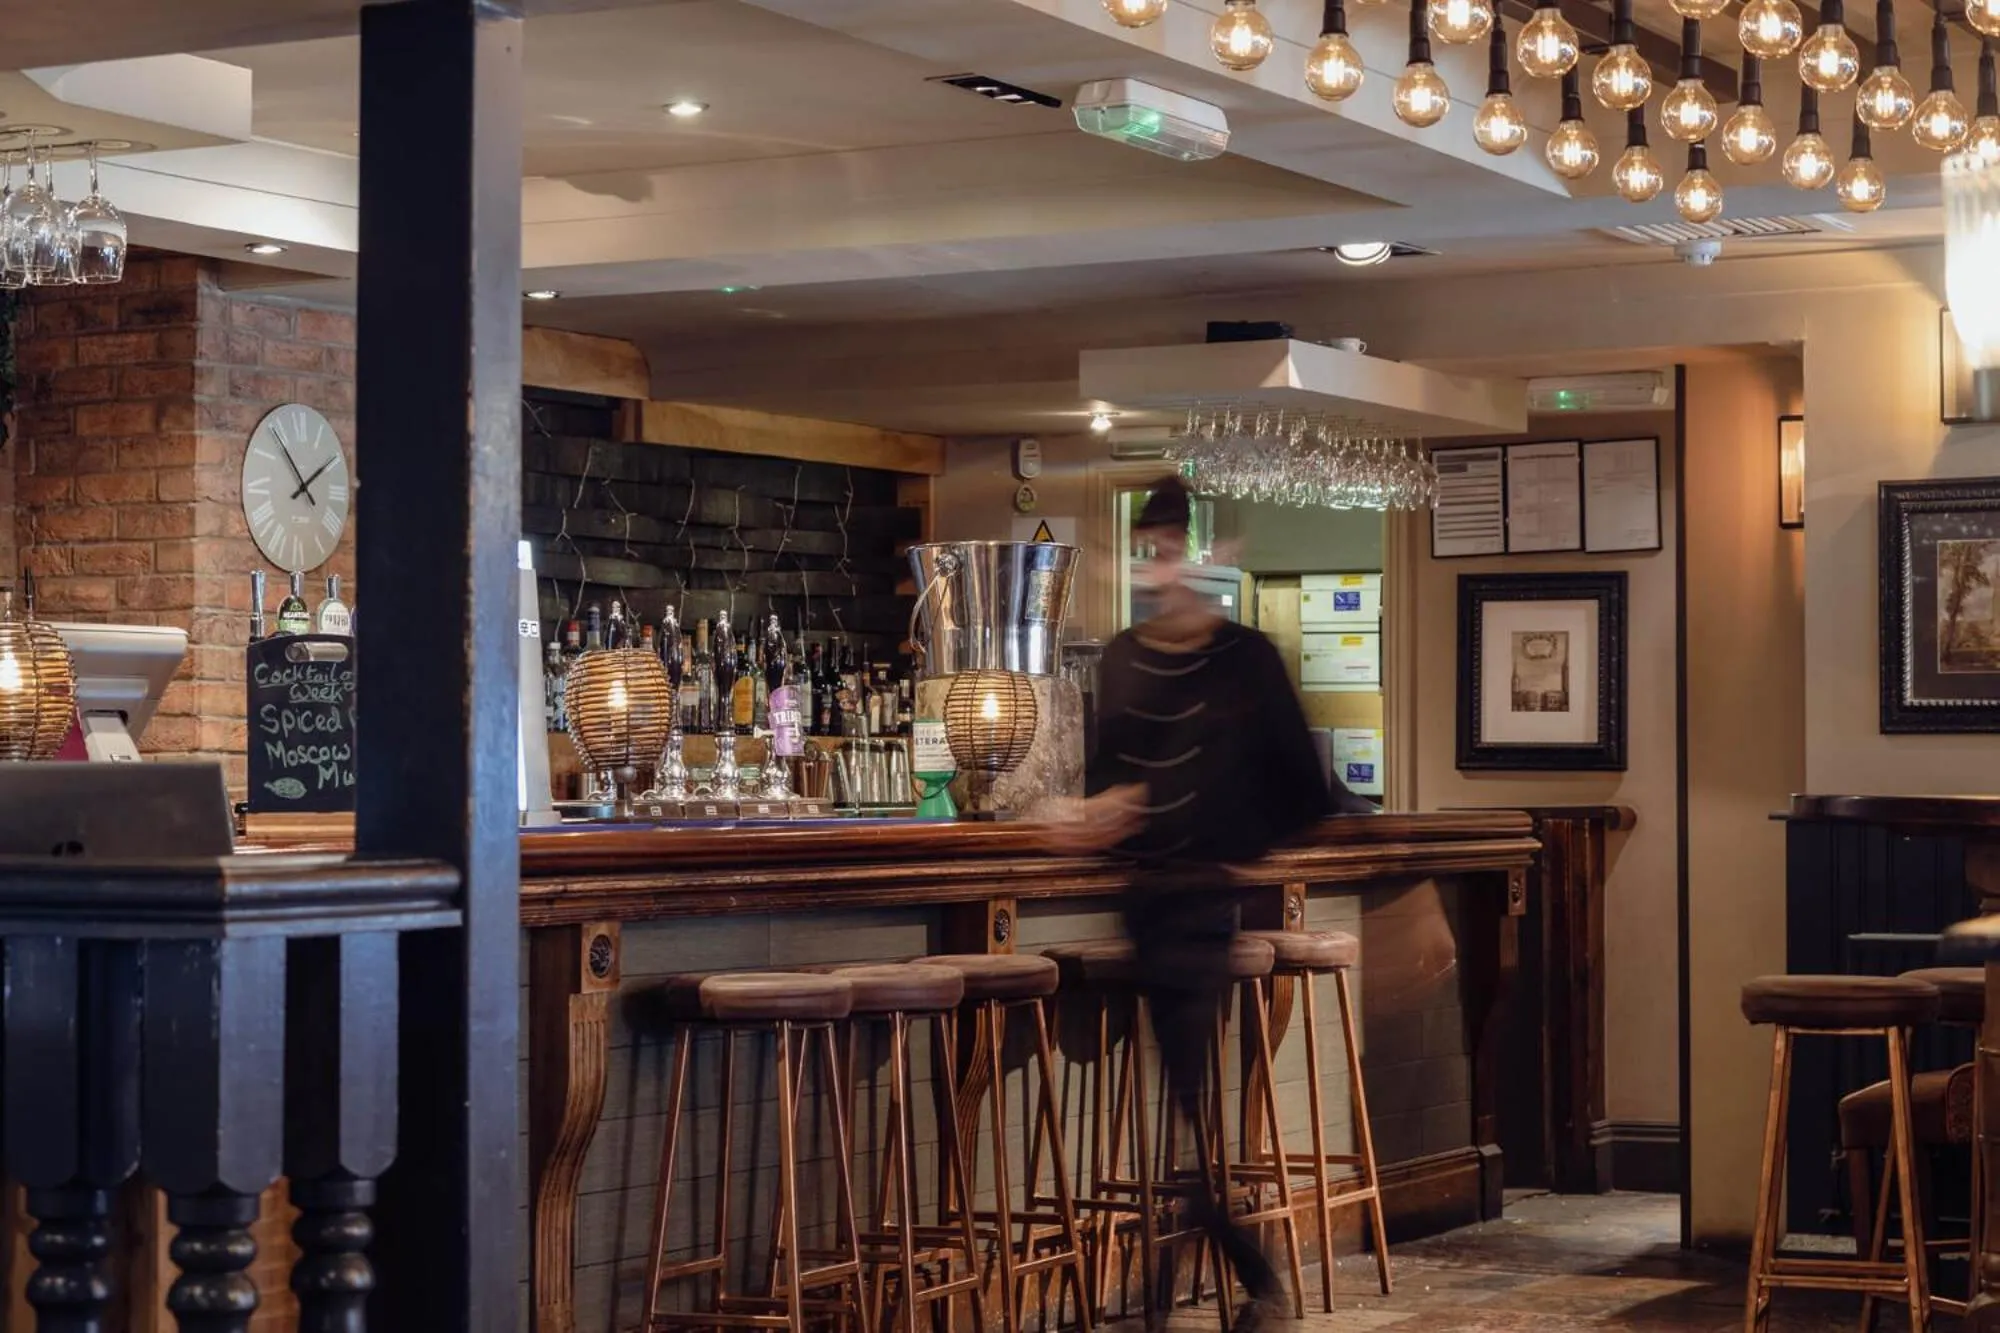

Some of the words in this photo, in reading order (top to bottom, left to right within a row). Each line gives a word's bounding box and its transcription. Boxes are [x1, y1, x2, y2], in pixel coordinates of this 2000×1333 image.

[254, 663, 338, 684] Cocktail
[289, 683, 344, 701] Week
[260, 703, 344, 738] Spiced
[264, 740, 351, 769] Moscow
